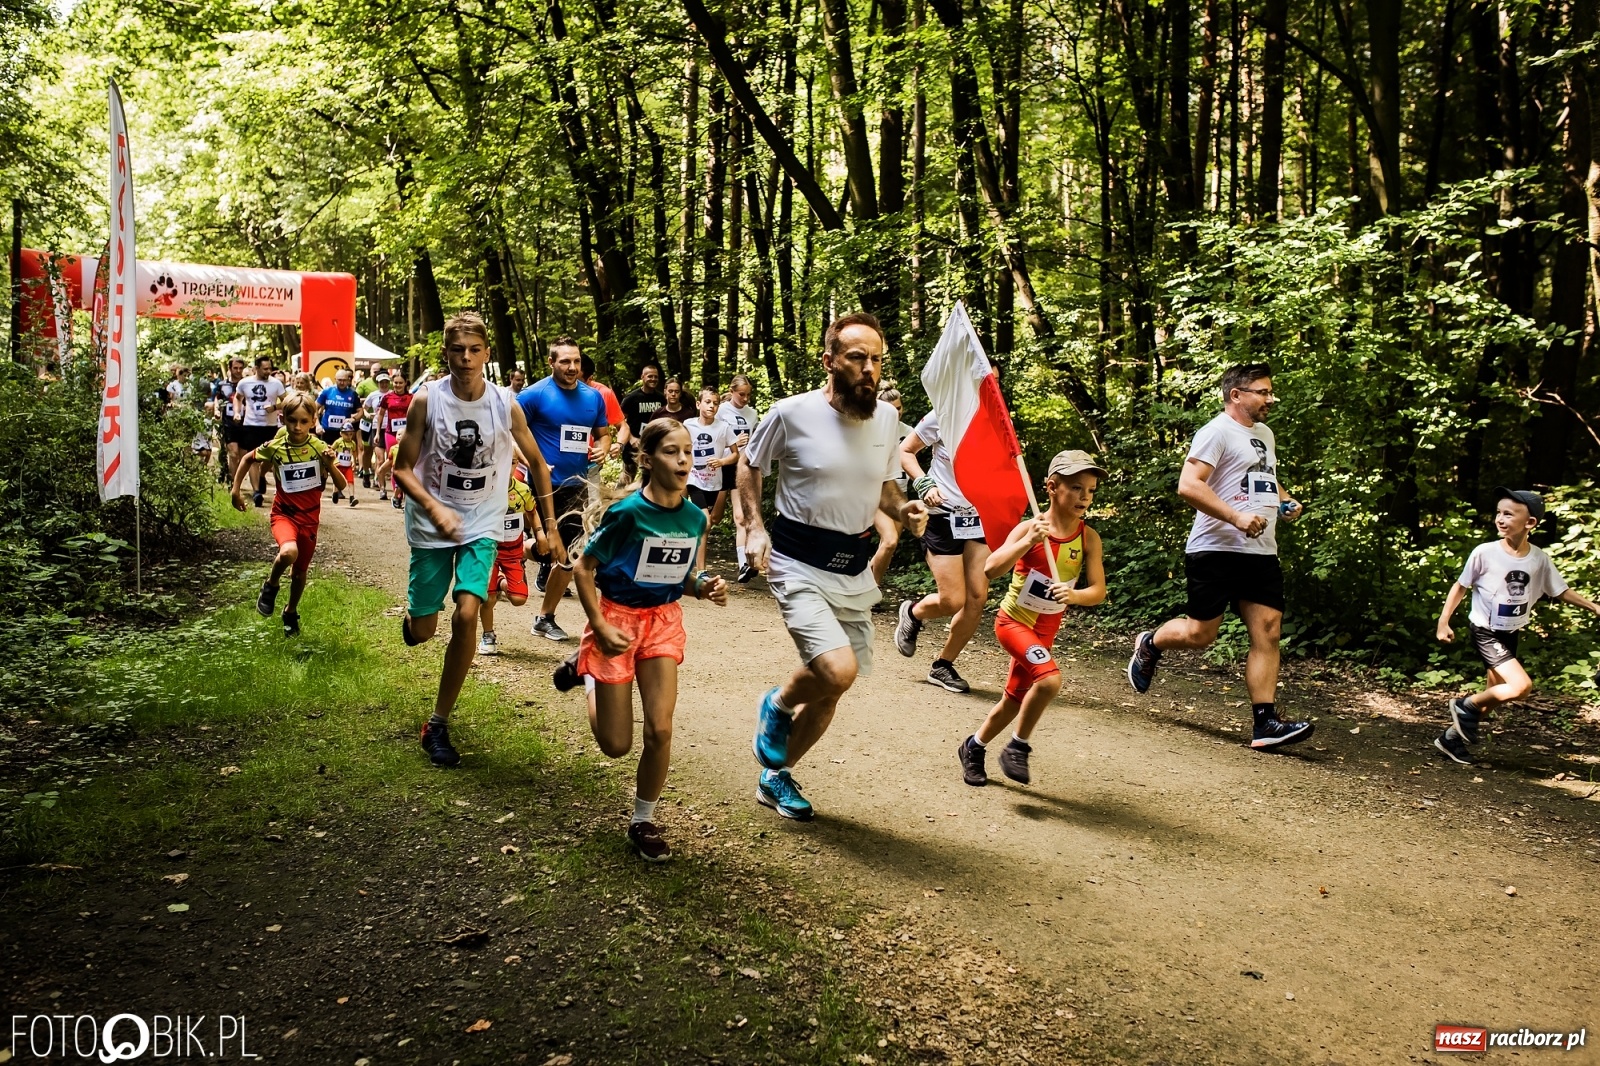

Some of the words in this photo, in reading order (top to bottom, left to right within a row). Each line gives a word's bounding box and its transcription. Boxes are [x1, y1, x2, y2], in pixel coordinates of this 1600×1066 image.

[236, 286, 293, 301] WILCZYM
[571, 431, 583, 441] 39
[292, 469, 307, 479] 47
[462, 479, 473, 490] 6
[1264, 481, 1272, 492] 2
[504, 520, 512, 529] 5
[962, 516, 975, 527] 34
[661, 548, 682, 563] 75
[1512, 605, 1521, 616] 4
[1032, 649, 1046, 660] B
